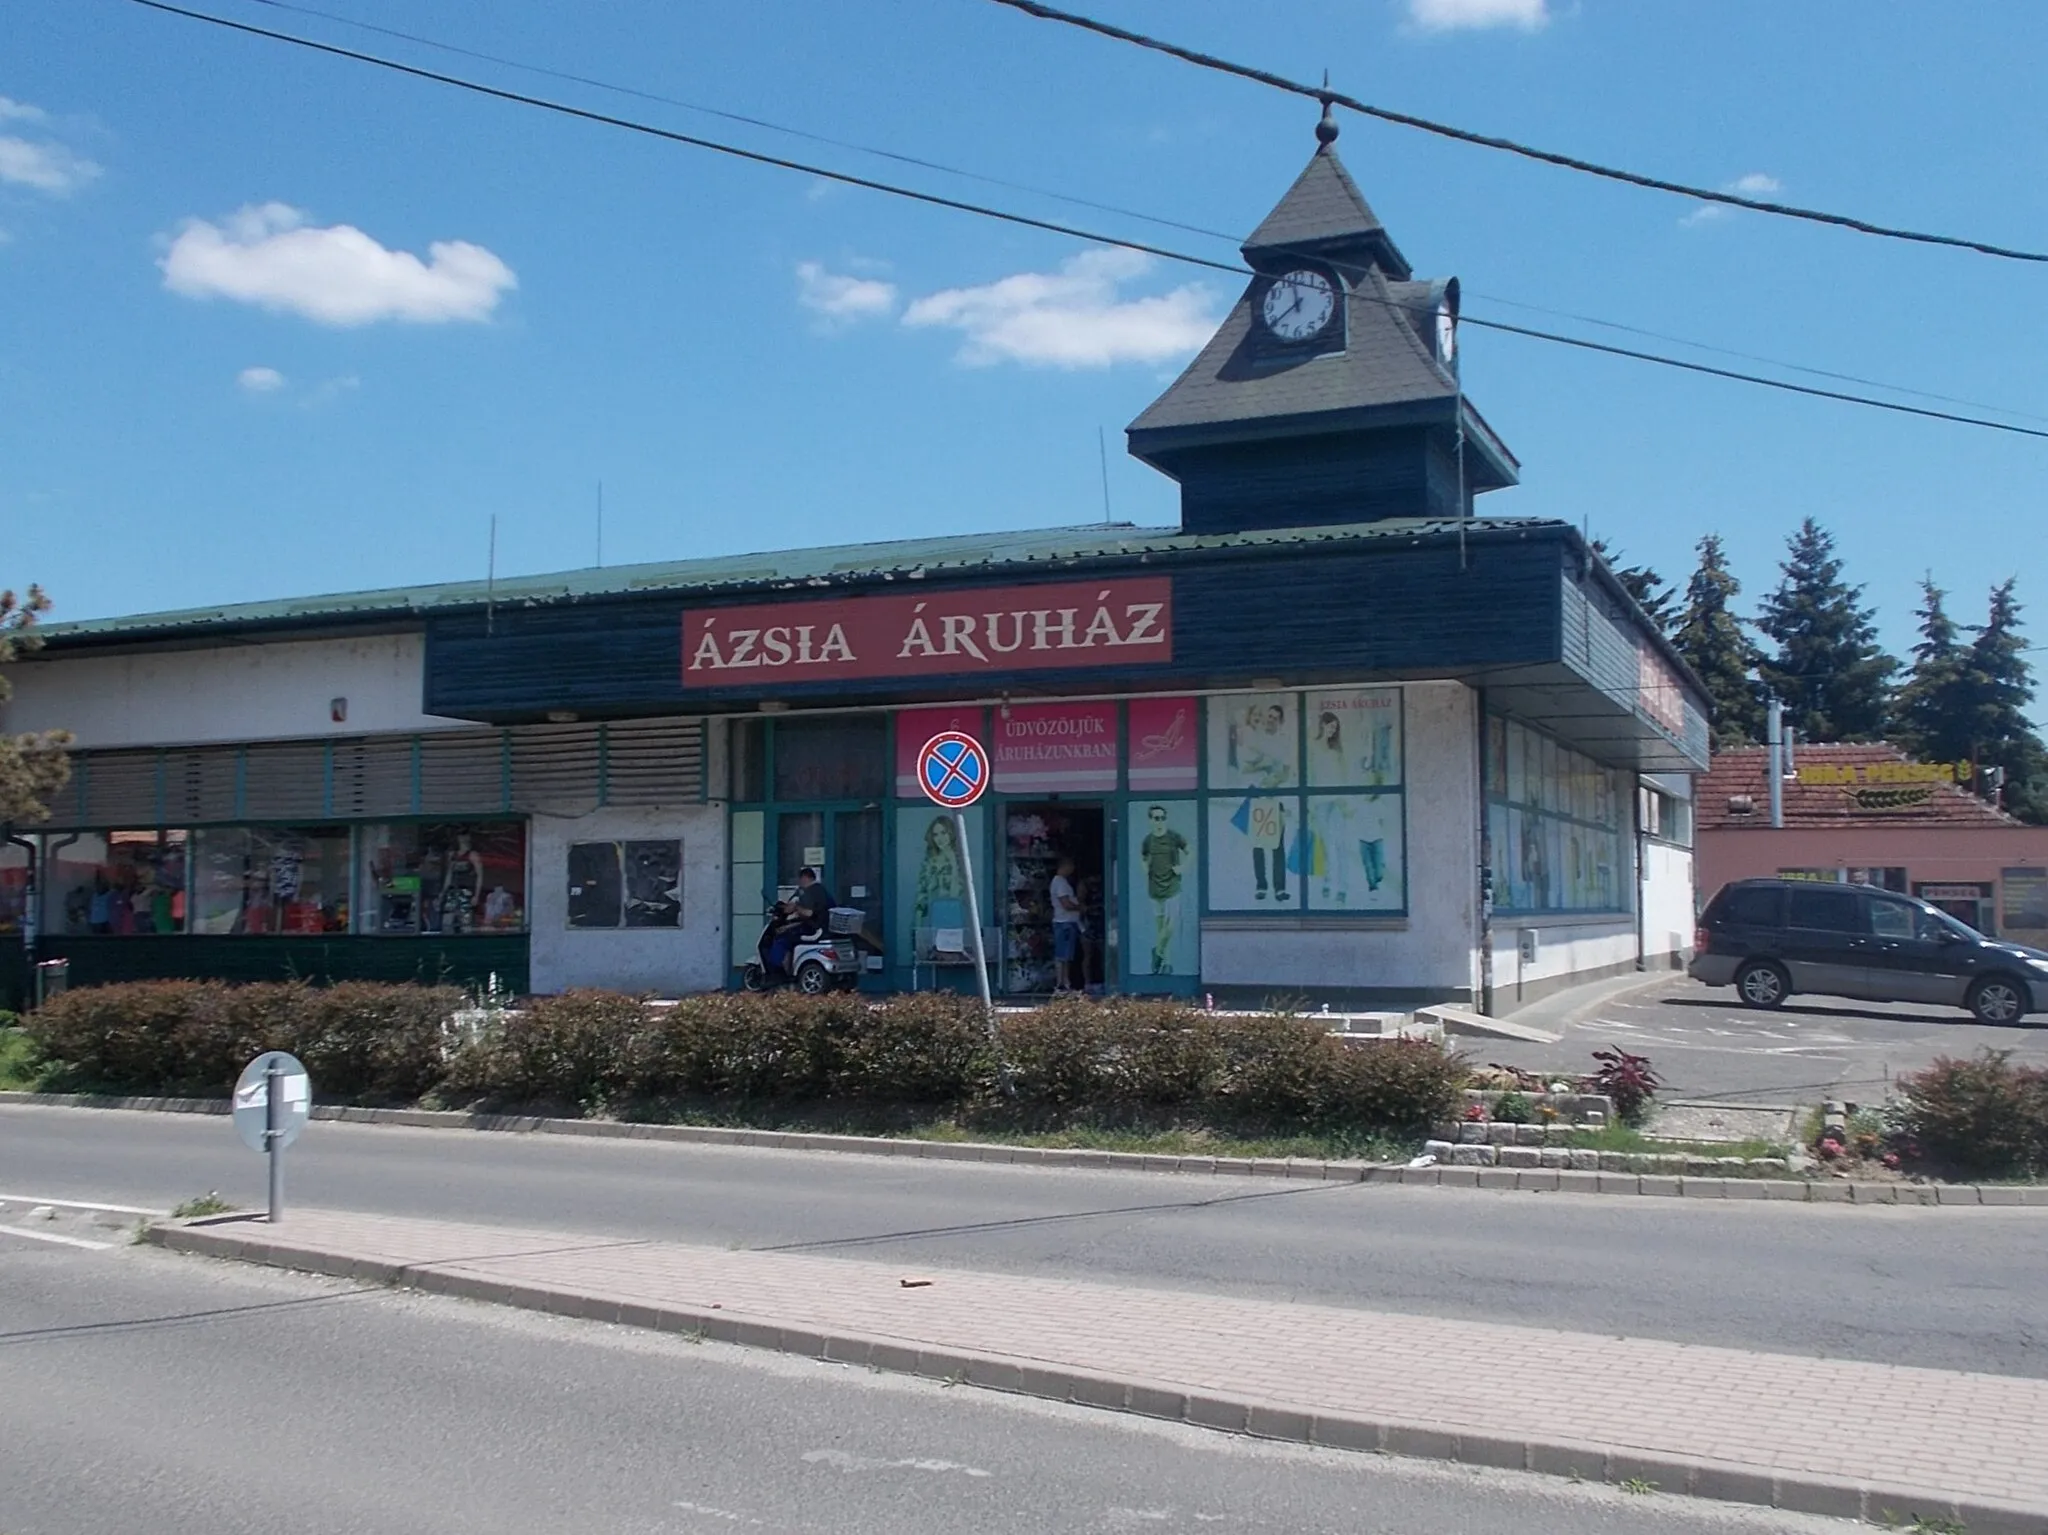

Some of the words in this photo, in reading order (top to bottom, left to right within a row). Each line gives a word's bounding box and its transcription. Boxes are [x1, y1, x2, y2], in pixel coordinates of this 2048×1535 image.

[1266, 302, 1274, 315] 9
[1325, 295, 1332, 309] 3
[1317, 309, 1326, 323] 4
[1281, 324, 1290, 337] 7
[1293, 325, 1302, 338] 6
[688, 618, 857, 671] ÁZSIA
[896, 590, 1165, 663] ÁRUHÁZ
[1005, 715, 1104, 738] ÜDVÖZÖLJÜK
[995, 742, 1117, 761] ÁRUHÁZUNKBAN!
